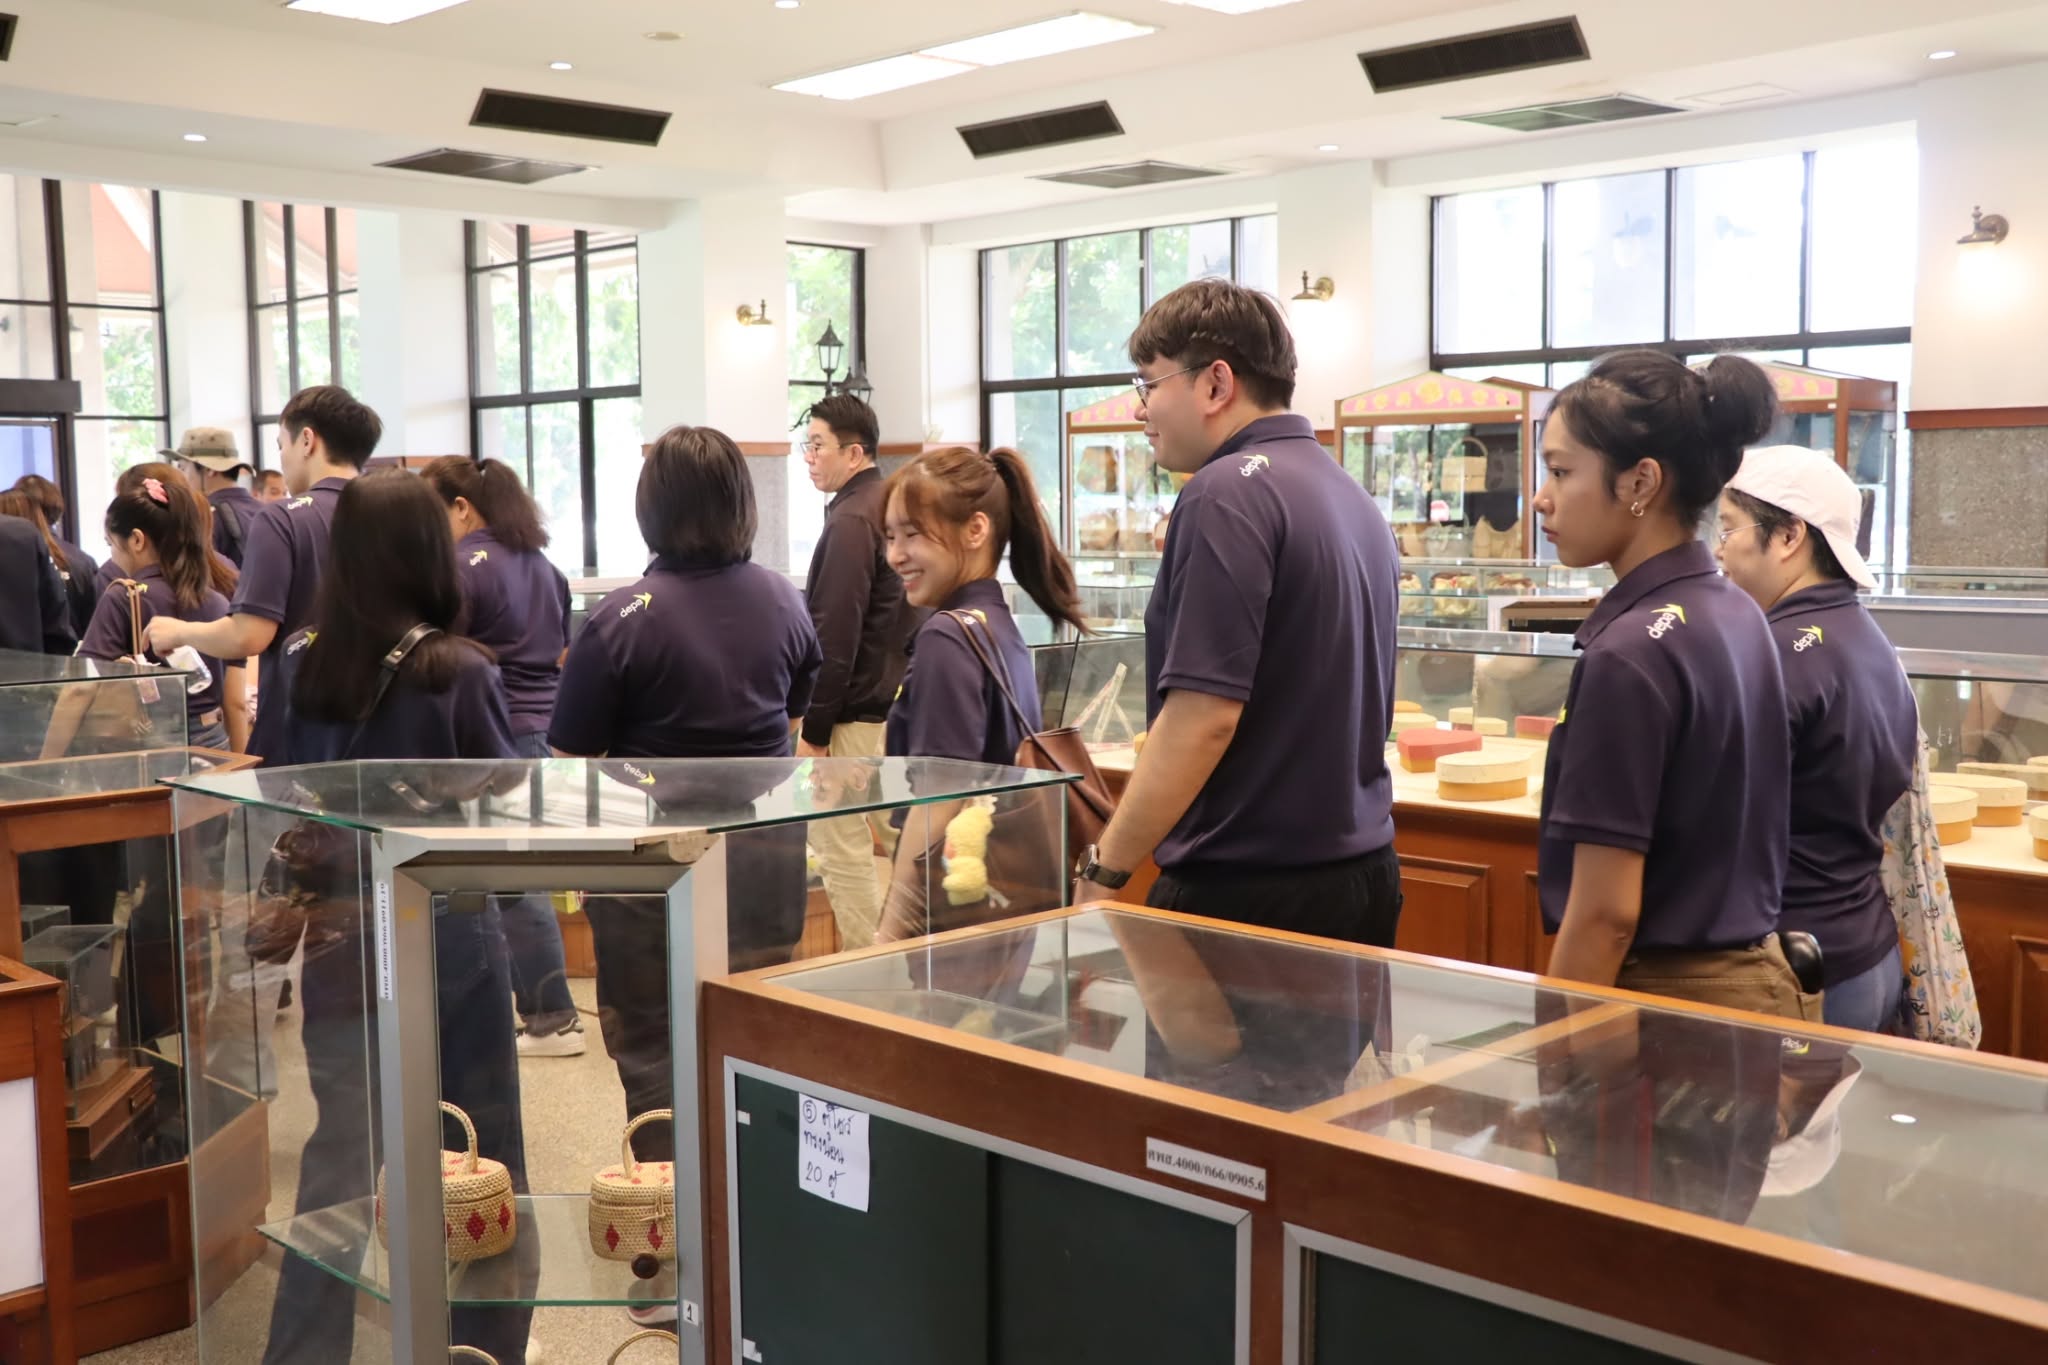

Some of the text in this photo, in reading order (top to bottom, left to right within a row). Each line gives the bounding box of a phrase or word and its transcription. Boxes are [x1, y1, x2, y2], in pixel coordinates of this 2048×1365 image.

[620, 599, 643, 618] depa
[1645, 612, 1677, 639] depa
[1793, 632, 1816, 652] depa
[806, 1161, 822, 1182] 20
[686, 1303, 694, 1322] 1
